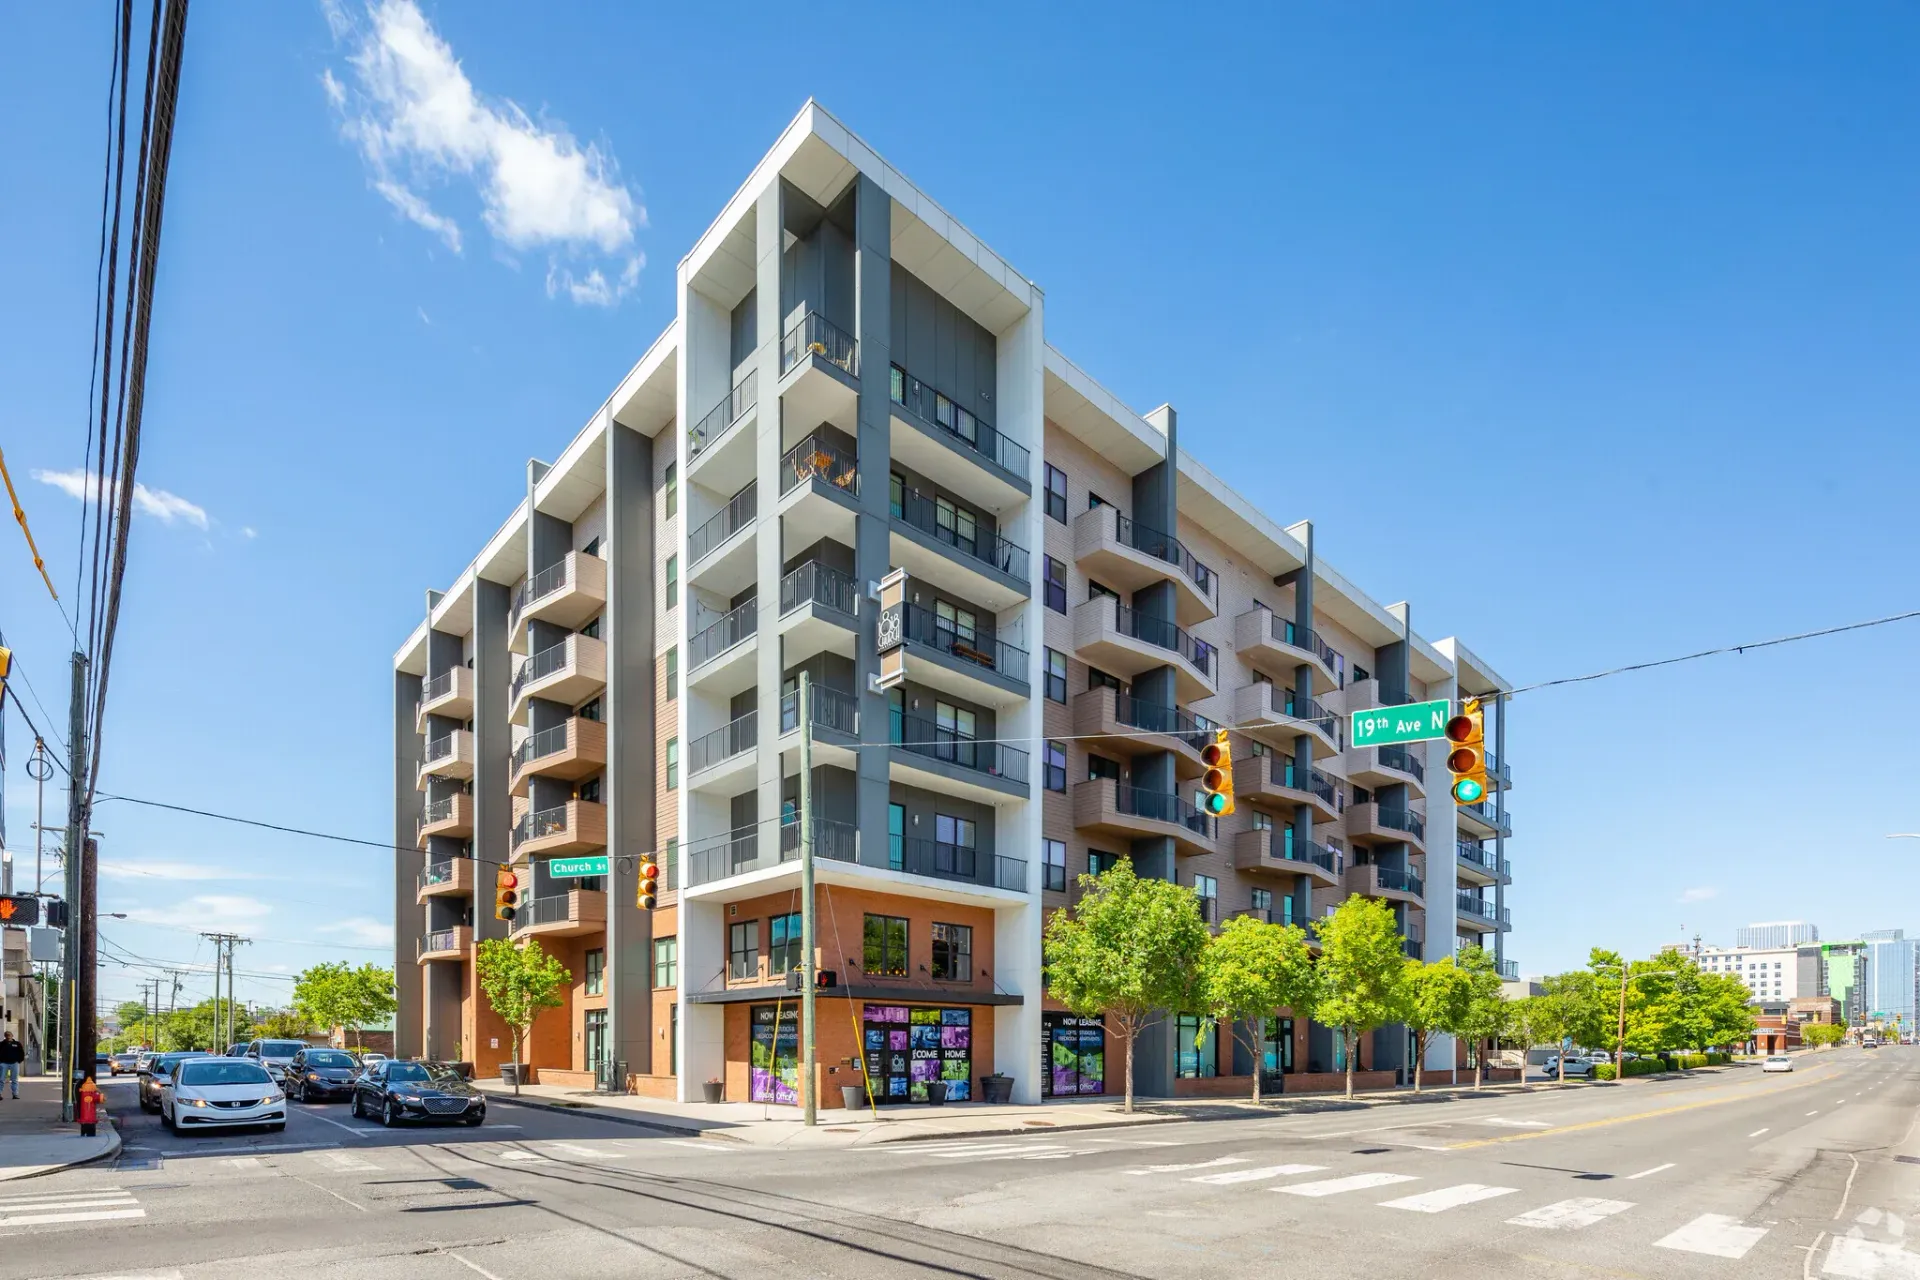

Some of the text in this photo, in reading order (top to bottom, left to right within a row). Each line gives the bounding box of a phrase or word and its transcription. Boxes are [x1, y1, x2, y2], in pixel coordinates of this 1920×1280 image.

[1357, 710, 1444, 738] 19th Ave N
[553, 862, 592, 873] Church
[760, 1011, 775, 1020] NOW
[1062, 1017, 1102, 1026] NOW LEASING
[944, 1049, 966, 1058] HOME
